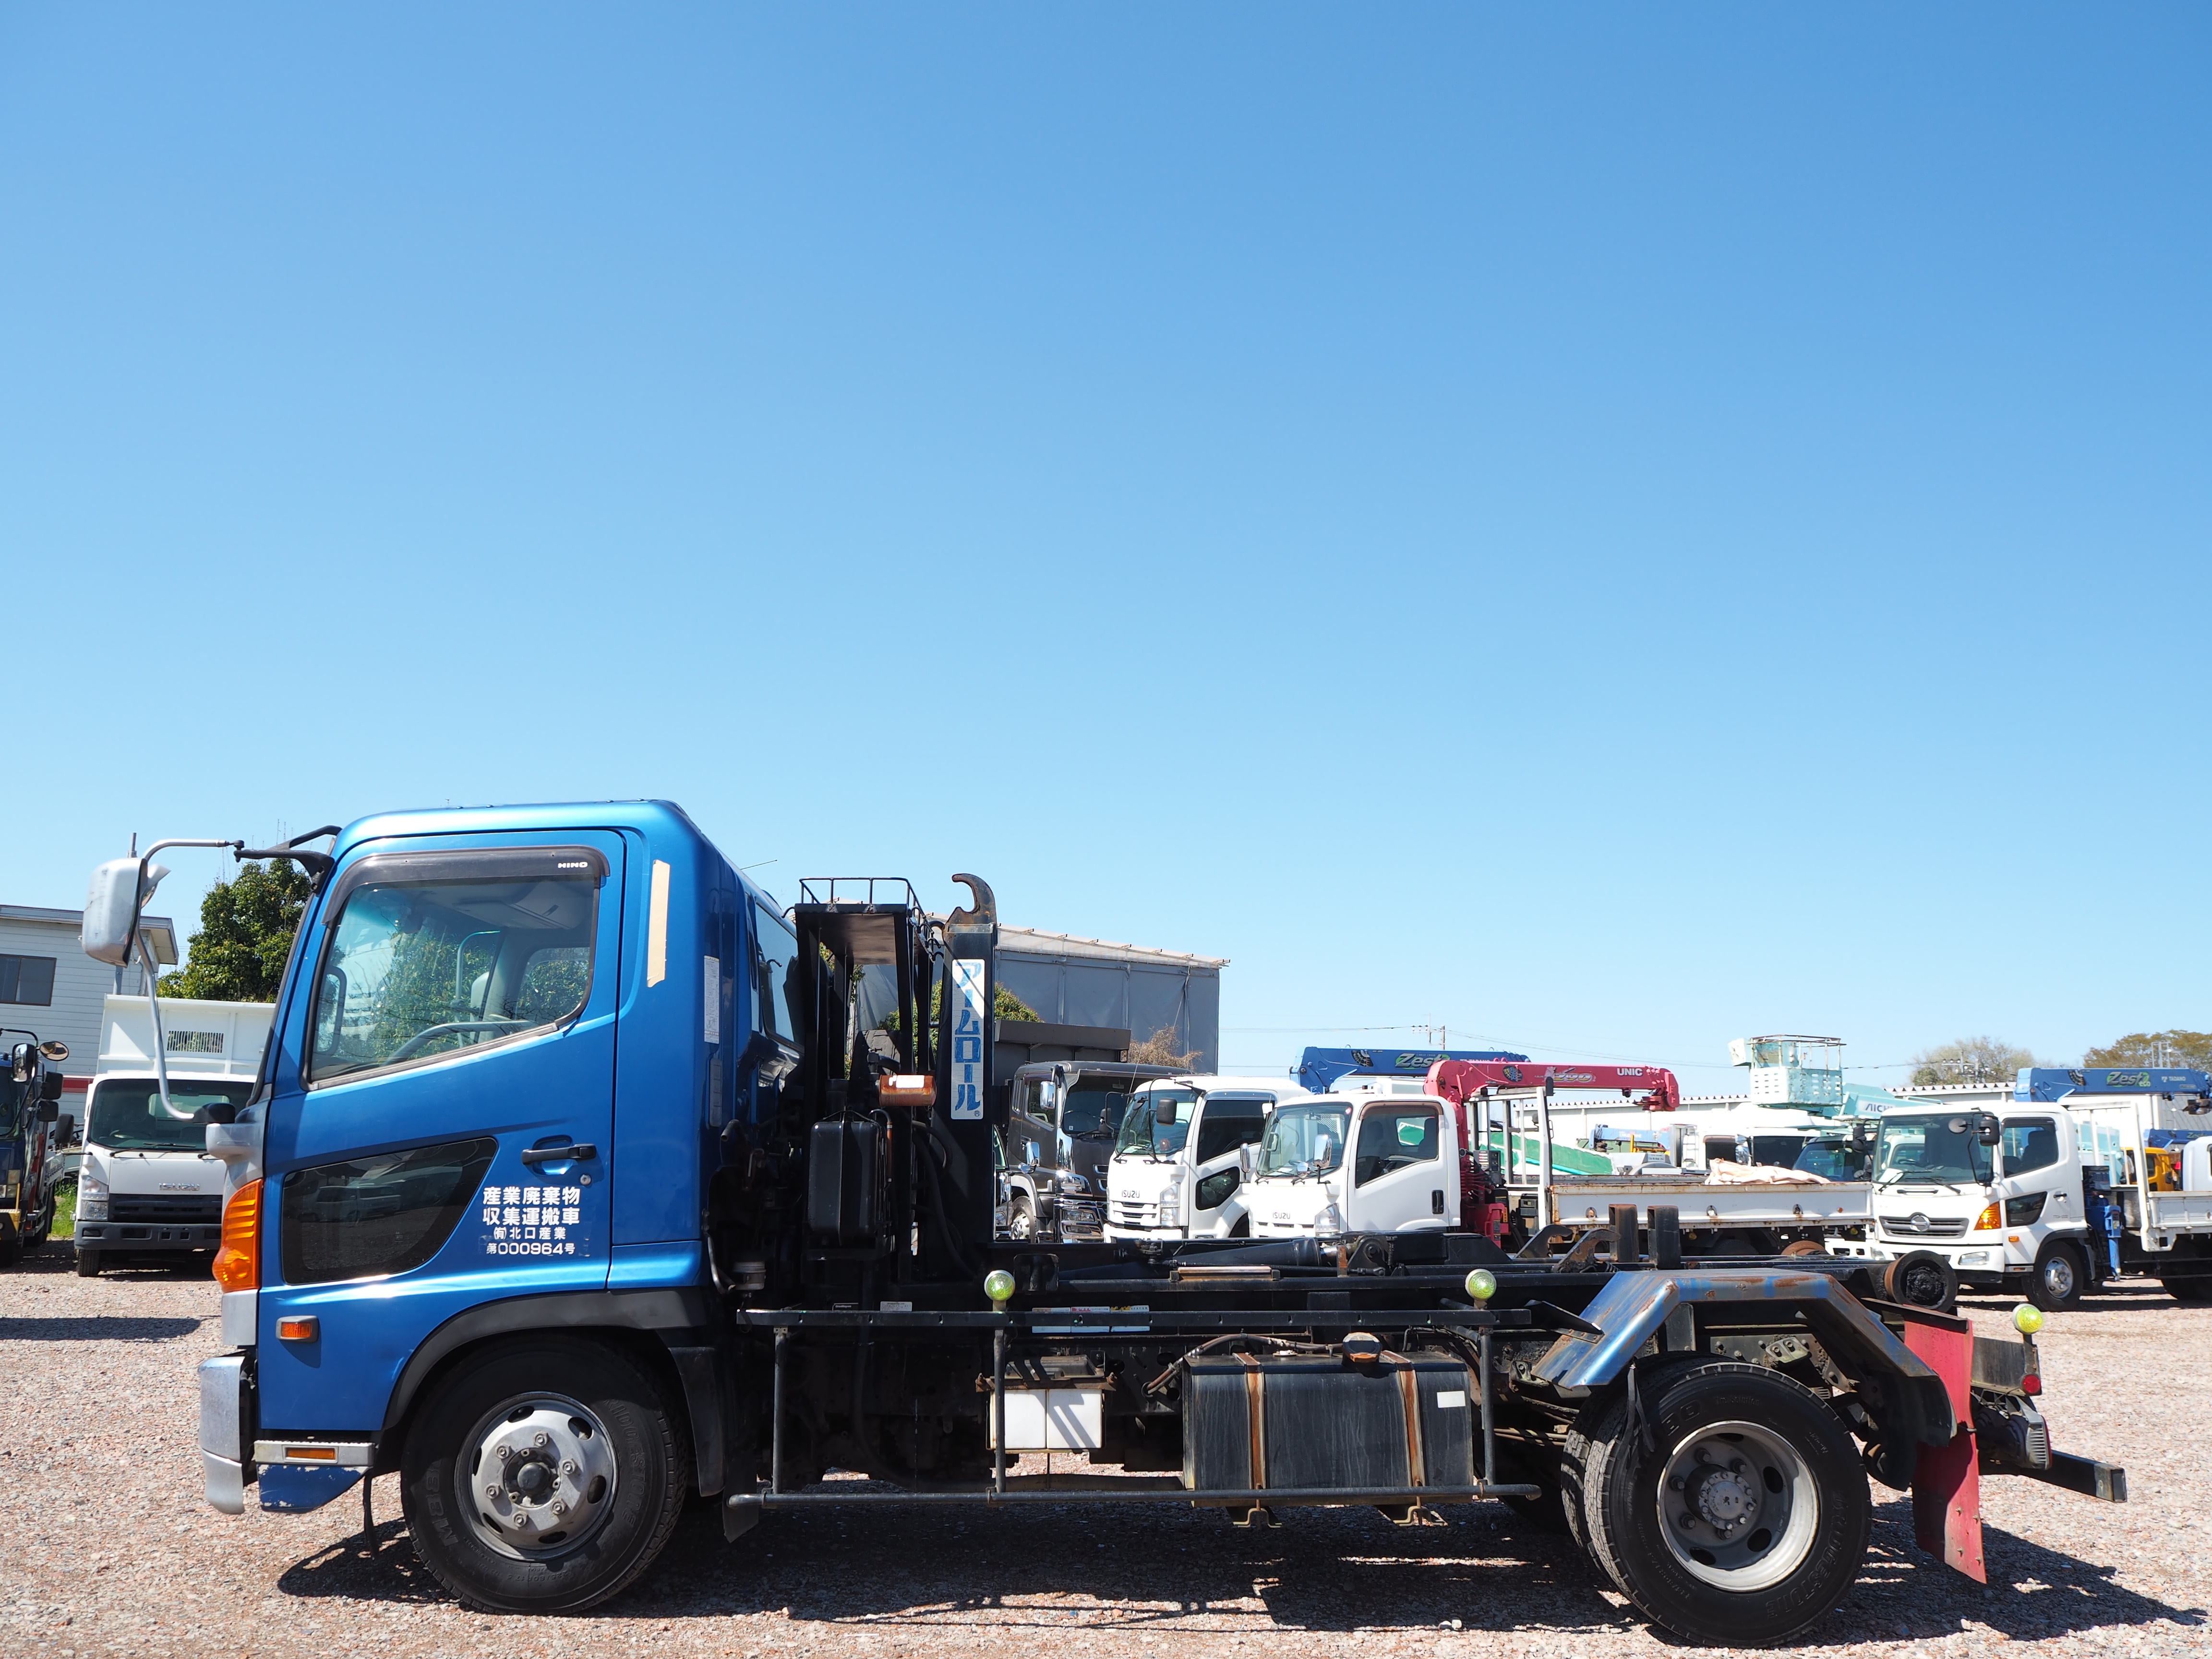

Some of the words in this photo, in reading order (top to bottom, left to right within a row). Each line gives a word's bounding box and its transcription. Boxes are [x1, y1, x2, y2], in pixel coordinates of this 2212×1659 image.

[955, 962, 982, 1111] アームロール
[1617, 1068, 1643, 1077] UNIC
[2106, 1071, 2143, 1086] Zest
[159, 1183, 201, 1191] ISUZU
[1121, 1190, 1140, 1198] ISUZU
[483, 1187, 580, 1205] 産業廃棄物
[482, 1207, 580, 1226] 収集運搬車
[486, 1242, 575, 1255] 第000964号
